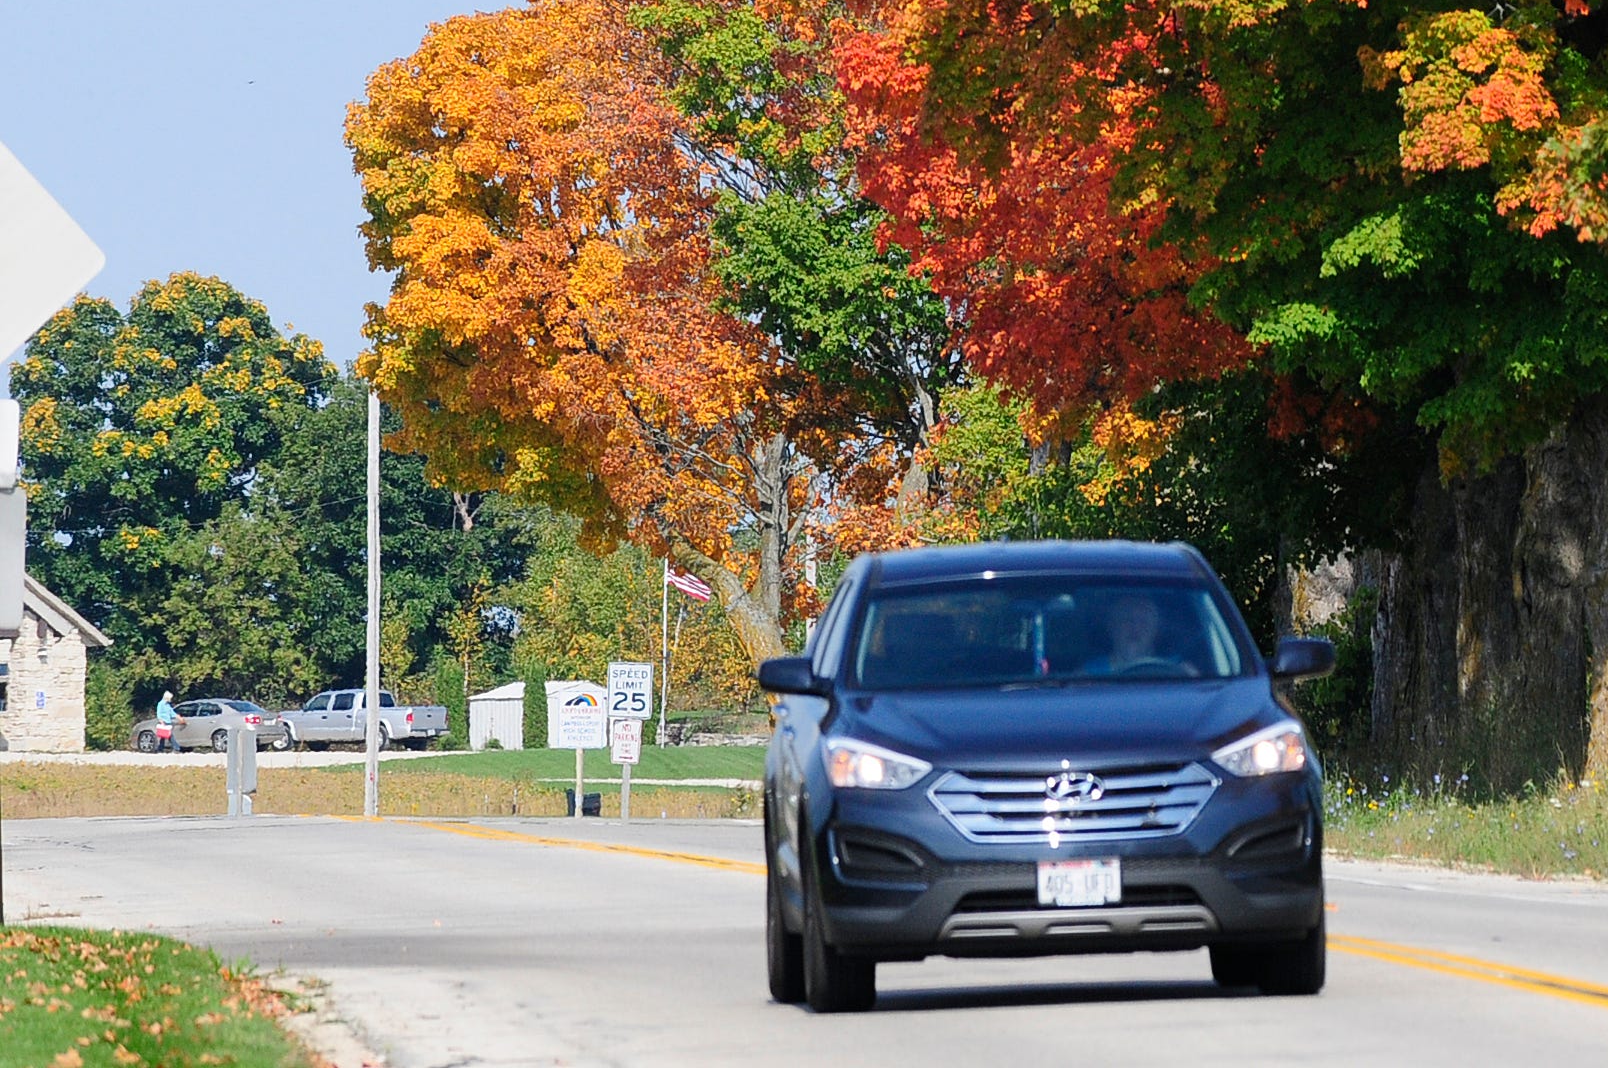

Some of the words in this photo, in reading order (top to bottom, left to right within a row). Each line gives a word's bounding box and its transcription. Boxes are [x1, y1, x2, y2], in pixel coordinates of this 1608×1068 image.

[612, 669, 648, 679] SPEED
[616, 681, 643, 690] LIMIT
[613, 692, 646, 712] 25
[622, 723, 632, 732] NO
